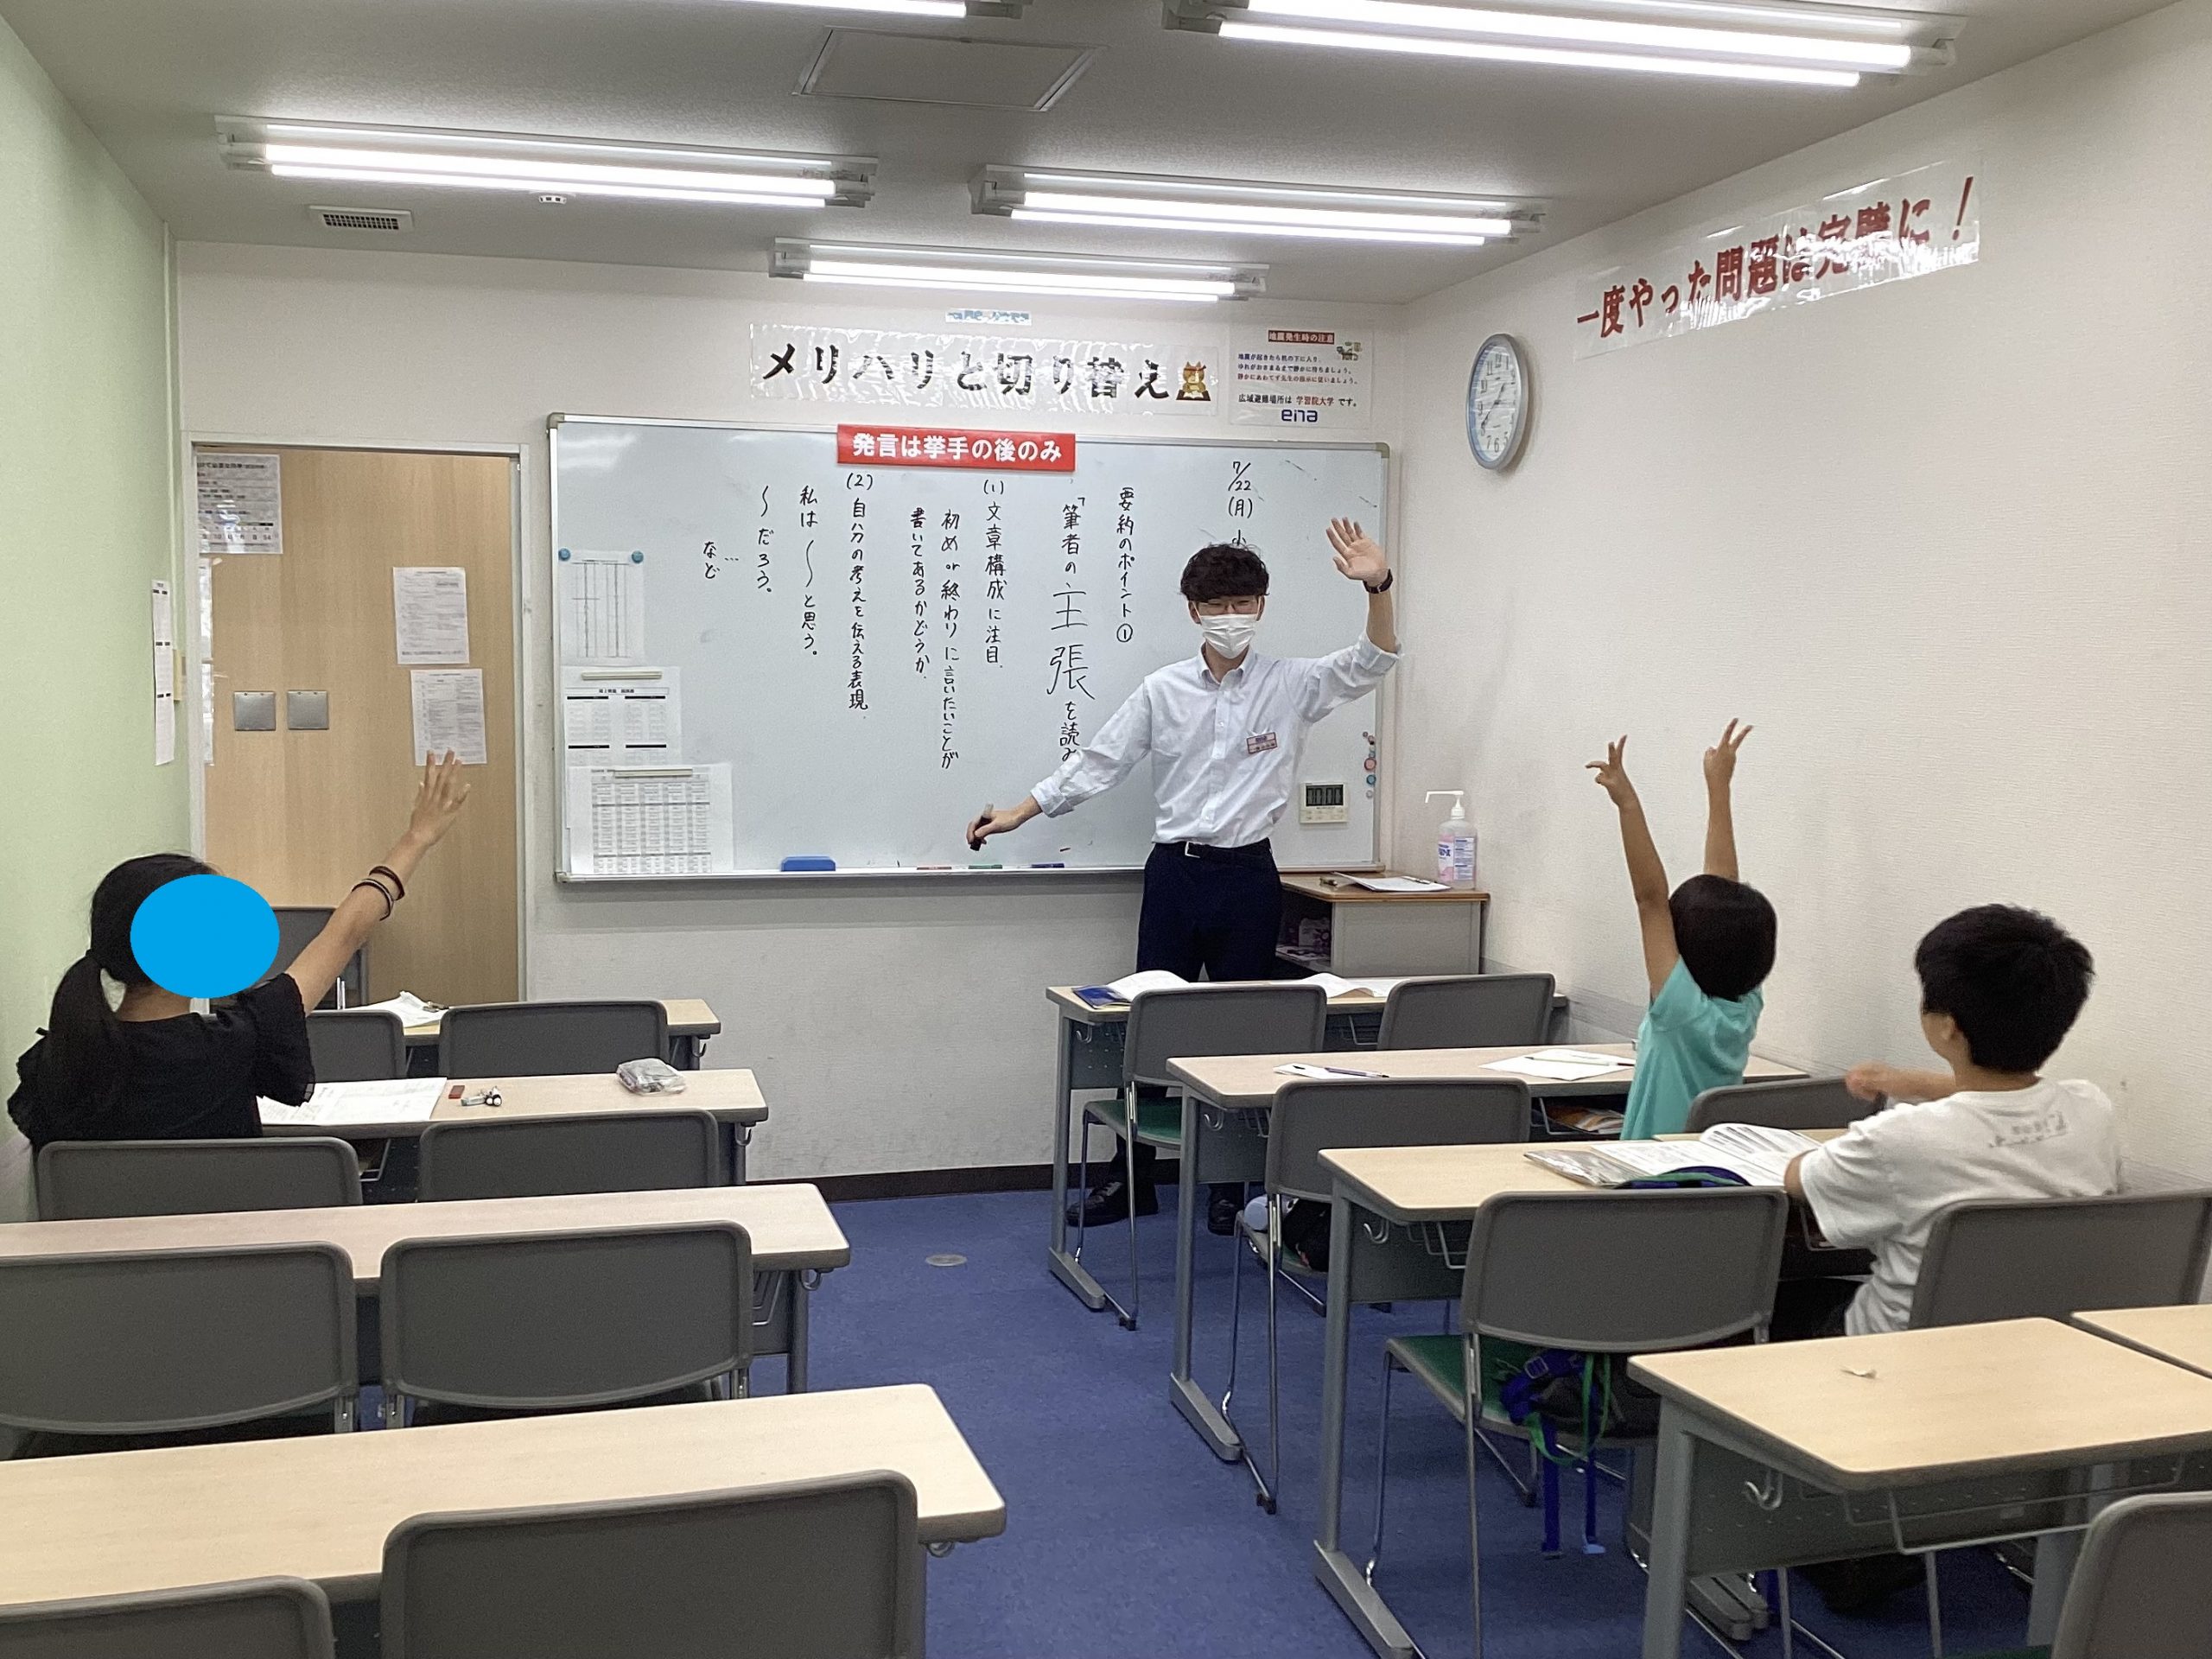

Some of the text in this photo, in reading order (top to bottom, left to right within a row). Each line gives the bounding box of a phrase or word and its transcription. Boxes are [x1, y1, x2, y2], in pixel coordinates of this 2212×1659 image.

[1268, 331, 1335, 344] 地震発生時の注意
[762, 342, 1170, 400] メリハリと切り替え
[1296, 396, 1335, 407] 学習院大学
[1281, 410, 1319, 423] ena
[852, 432, 1063, 462] 発言は挙手の後のみ
[1494, 437, 1500, 453] 6
[1228, 461, 1252, 492] 7/22
[1228, 496, 1253, 518] (月)
[703, 541, 721, 579] など
[1116, 486, 1135, 644] 要約のポイント①
